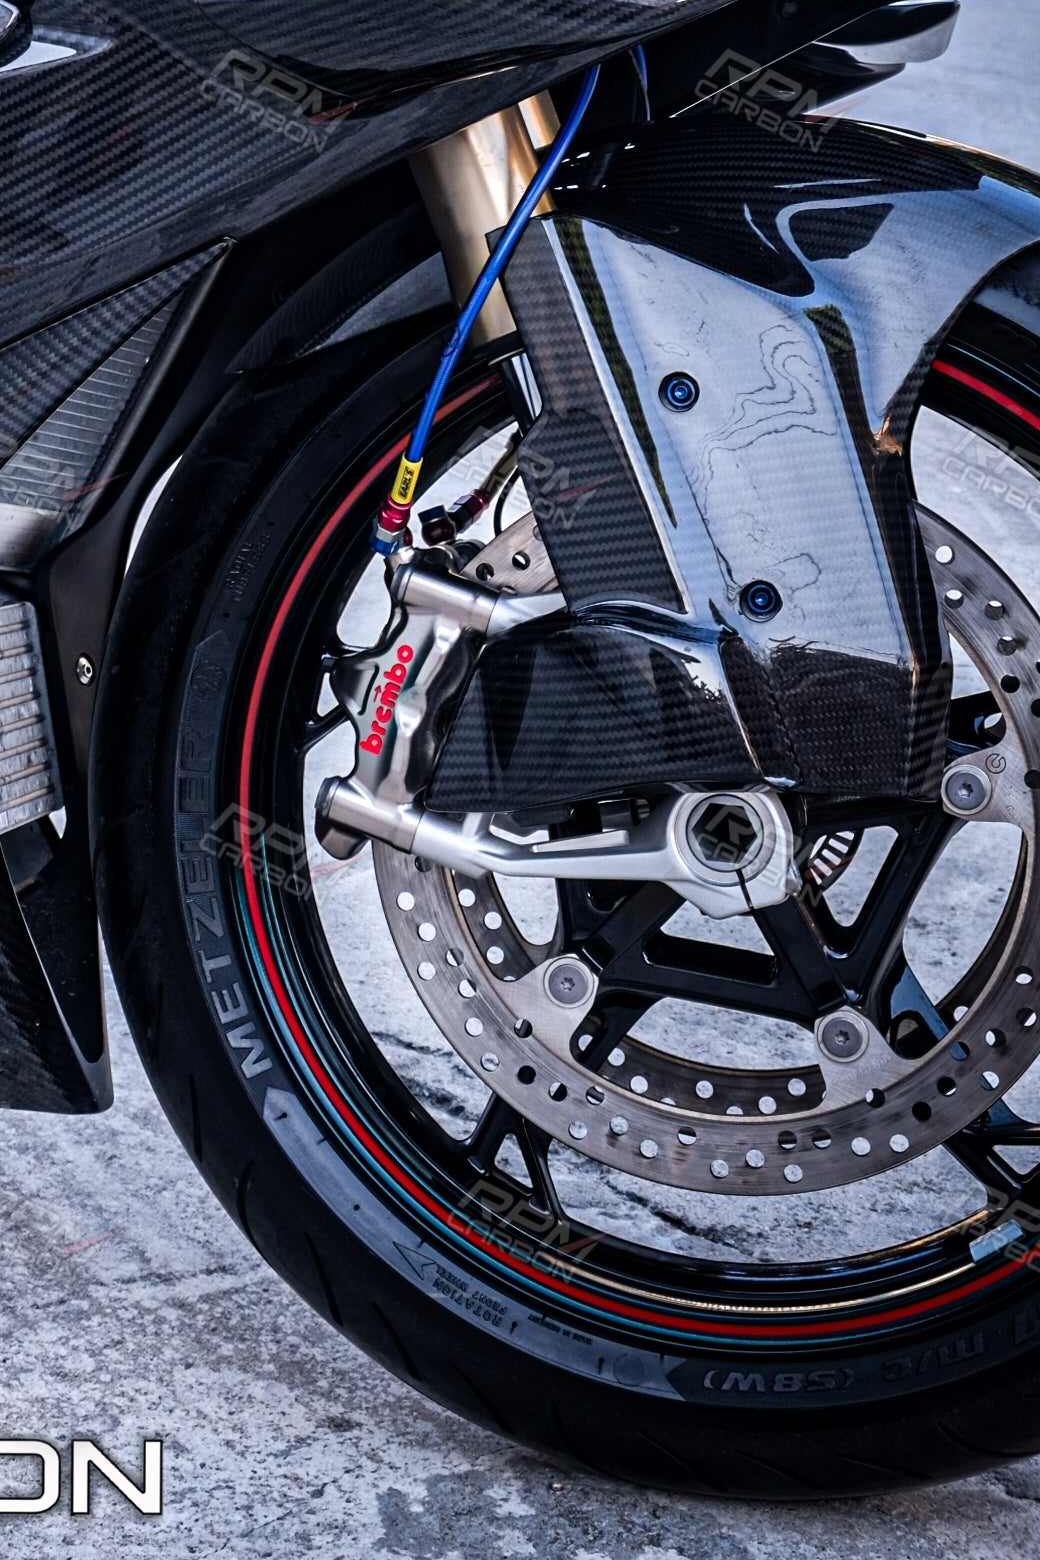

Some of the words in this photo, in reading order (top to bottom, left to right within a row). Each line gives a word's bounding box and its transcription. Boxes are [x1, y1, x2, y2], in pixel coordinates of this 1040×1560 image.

[359, 645, 414, 755] brembo
[177, 729, 273, 1080] METZELER
[436, 1263, 469, 1291] WHEEL
[432, 1278, 503, 1327] ROTATION
[471, 1290, 509, 1316] FRONT
[703, 1367, 856, 1392] (58W)
